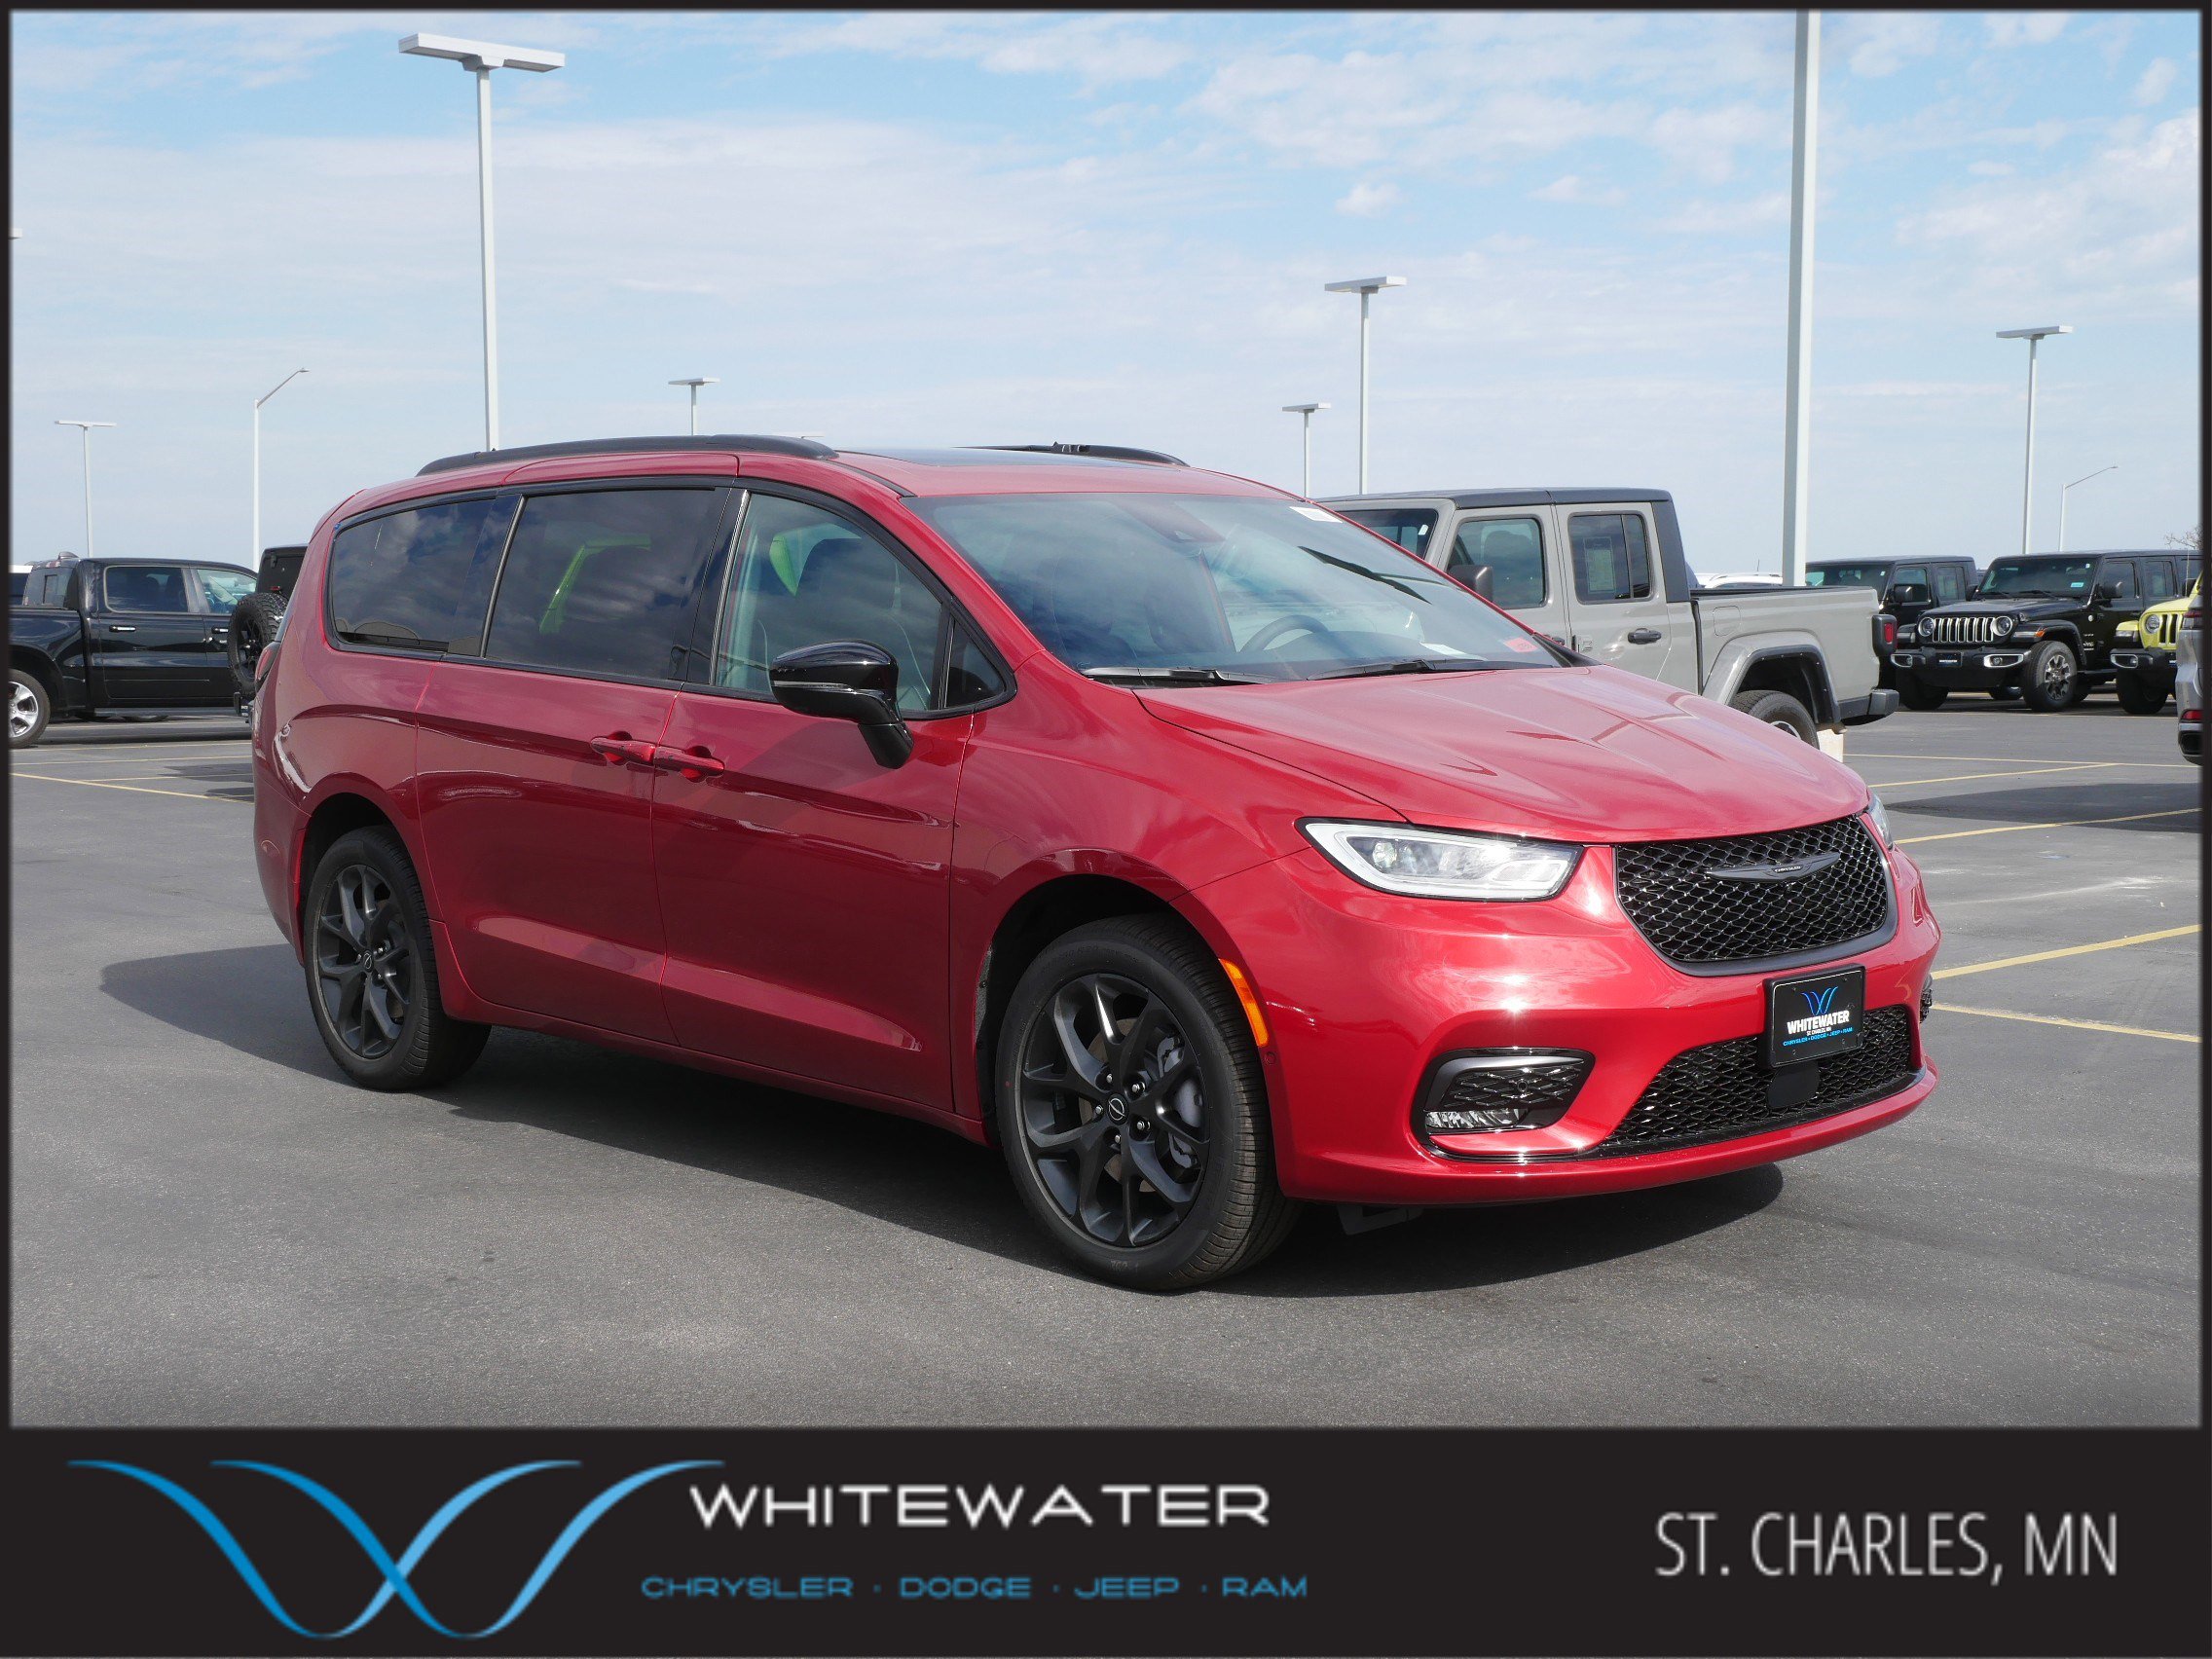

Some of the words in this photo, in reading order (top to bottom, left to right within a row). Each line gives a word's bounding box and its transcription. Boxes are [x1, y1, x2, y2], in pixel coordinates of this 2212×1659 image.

[1787, 1011, 1850, 1034] WHITEWATER
[1783, 1036, 1808, 1047] CHRYSLER
[1810, 1032, 1827, 1041] DODGE
